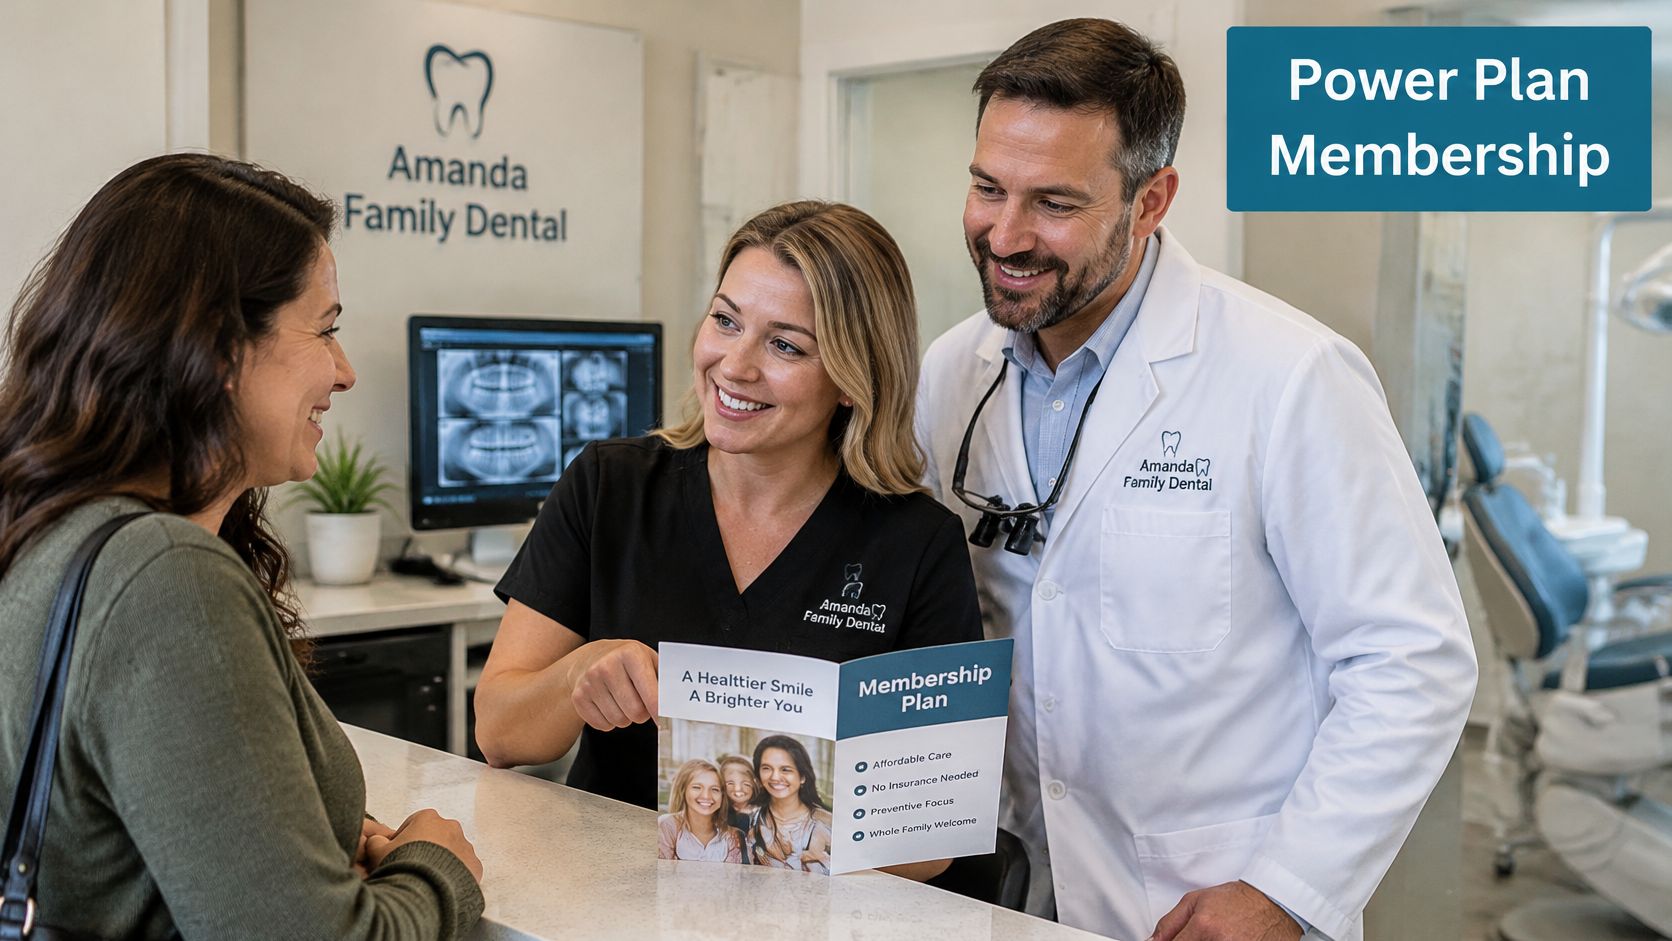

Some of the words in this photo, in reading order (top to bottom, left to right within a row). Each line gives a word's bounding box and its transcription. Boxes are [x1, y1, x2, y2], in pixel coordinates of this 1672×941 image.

[387, 145, 528, 190] Amanda
[344, 193, 455, 243] Family
[465, 203, 567, 241] Dental
[1139, 459, 1194, 473] Amanda
[1123, 476, 1165, 492] Family
[1168, 476, 1212, 491] Dental
[819, 599, 871, 616] Amanda
[803, 610, 843, 629] Family
[846, 616, 886, 633] Dental
[682, 670, 693, 683] A
[698, 671, 767, 691] Healttier
[770, 679, 814, 697] Smile
[858, 663, 992, 698] Membership
[689, 689, 701, 702] A
[705, 690, 770, 709] Brighter
[774, 698, 803, 714] You
[901, 693, 948, 713] Plan
[872, 754, 925, 770] Affordable
[928, 751, 952, 761] Care
[871, 784, 886, 793] No
[889, 776, 938, 790] Insurance
[870, 801, 922, 816] Preventive
[925, 798, 954, 809] Focus
[869, 827, 900, 838] Whole
[934, 817, 977, 829] Welcome
